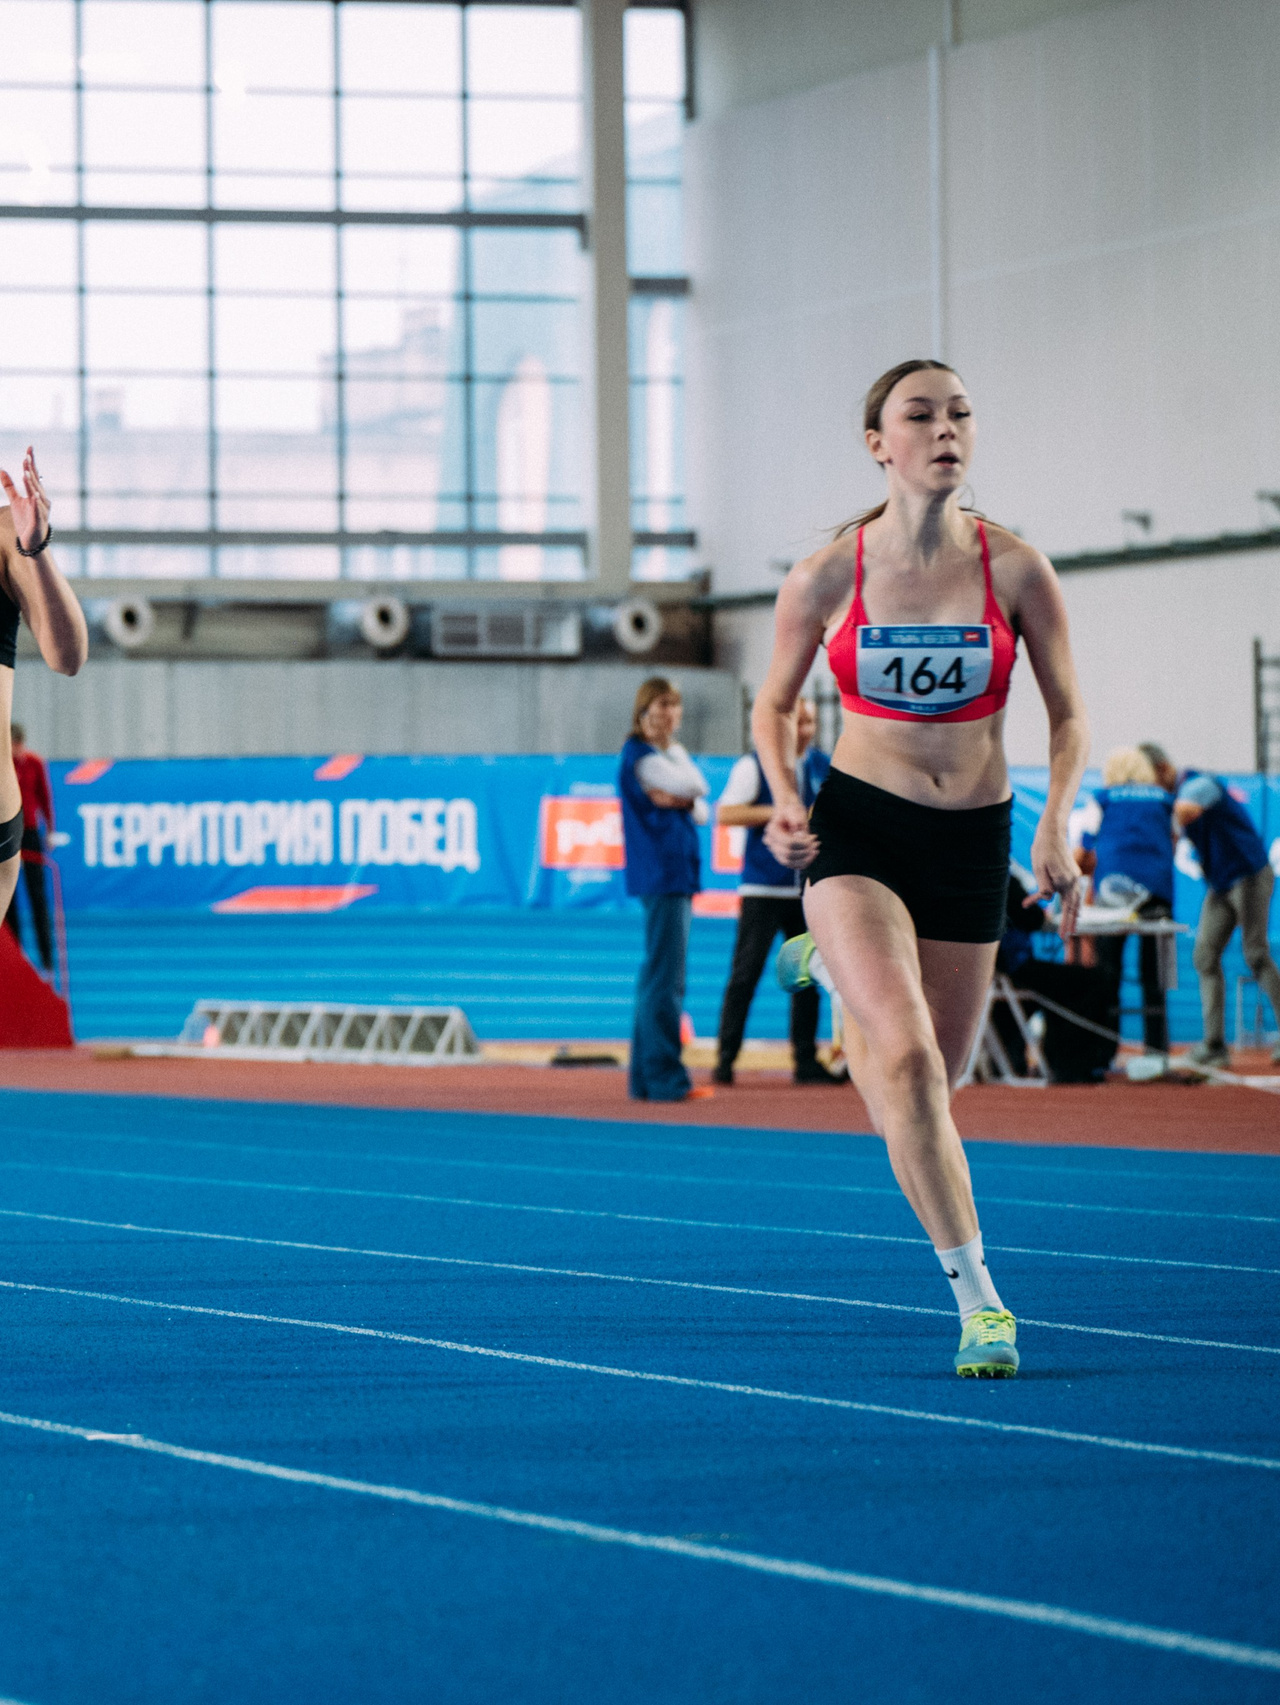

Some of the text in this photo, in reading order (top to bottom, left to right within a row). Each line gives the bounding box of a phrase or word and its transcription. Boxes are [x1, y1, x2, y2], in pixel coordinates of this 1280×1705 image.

[882, 656, 967, 696] 164
[77, 801, 334, 868] ТЕРРИТОРИЯ
[338, 798, 481, 873] ПОБЕД
